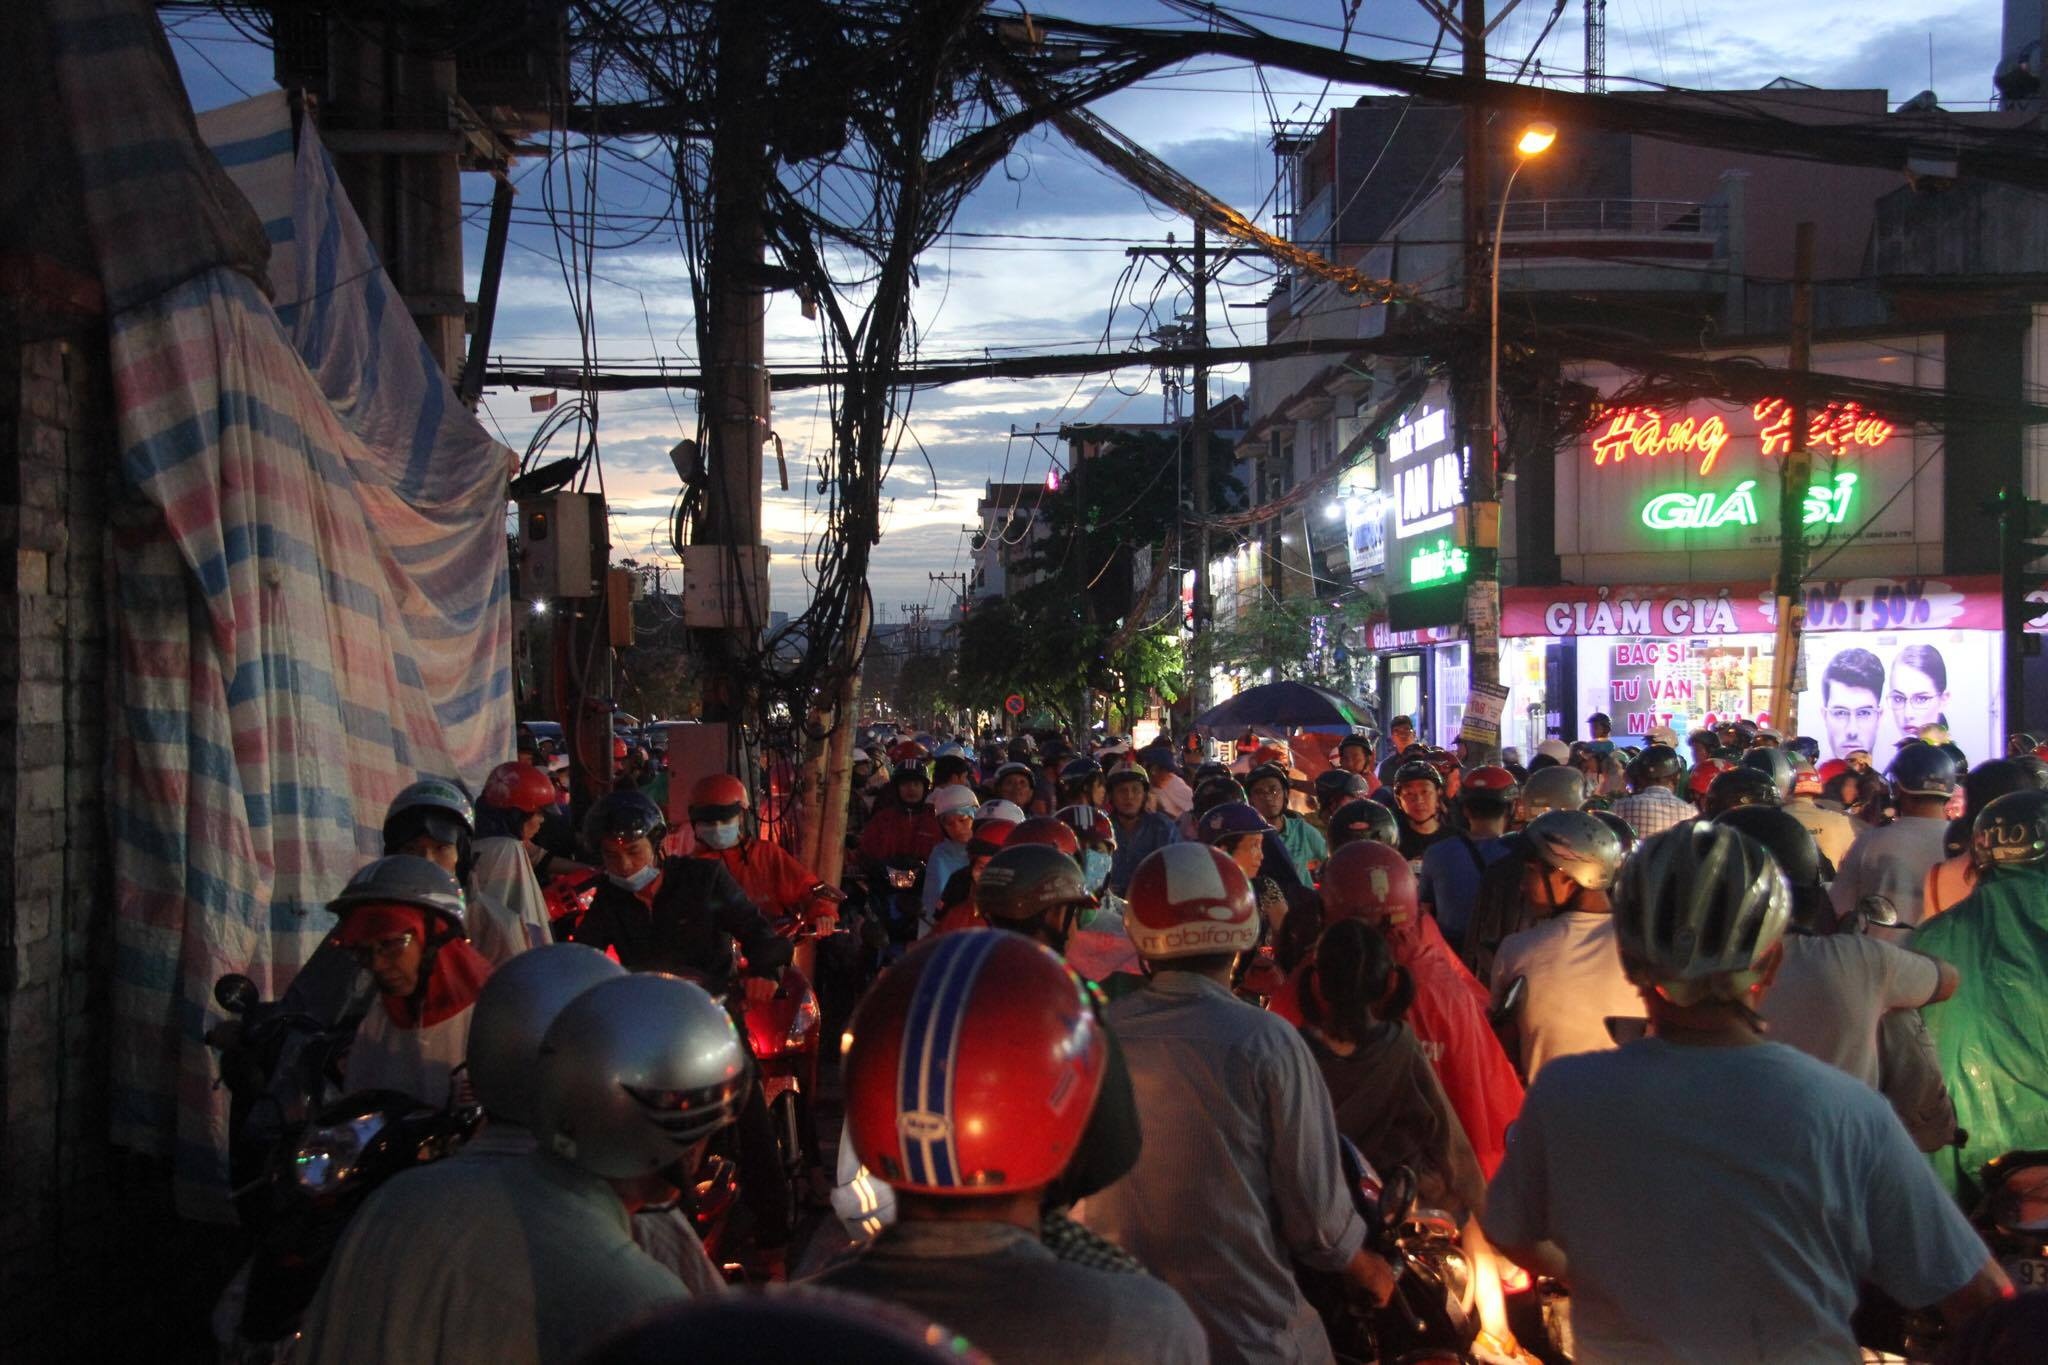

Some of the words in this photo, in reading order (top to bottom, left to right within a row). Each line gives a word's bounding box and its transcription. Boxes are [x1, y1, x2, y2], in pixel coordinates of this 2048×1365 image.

[1642, 480, 1758, 528] GIÁ
[1545, 586, 1652, 636] GIẢM
[1661, 588, 1739, 634] GIÁ
[1871, 578, 1931, 629] 50%
[1616, 637, 1660, 665] BÁC
[1611, 675, 1640, 702] TƯ
[1648, 671, 1693, 701] VẤN
[1628, 705, 1674, 735] MẮT
